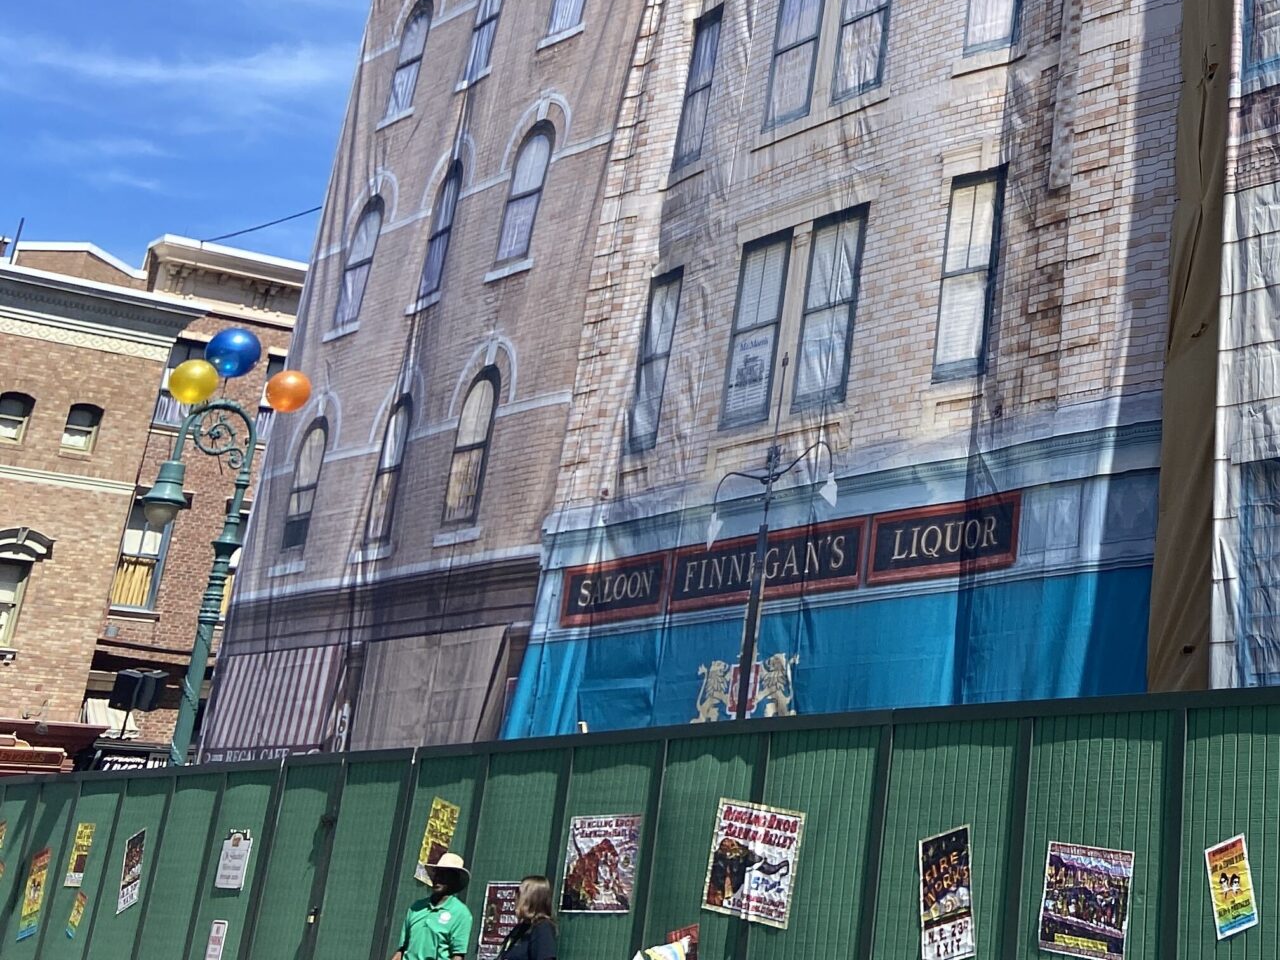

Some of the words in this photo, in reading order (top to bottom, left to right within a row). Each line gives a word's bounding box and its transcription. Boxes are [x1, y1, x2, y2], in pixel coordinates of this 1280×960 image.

[891, 515, 998, 560] LIQUOR
[577, 569, 655, 608] SALOON
[936, 938, 960, 958] EXIT
